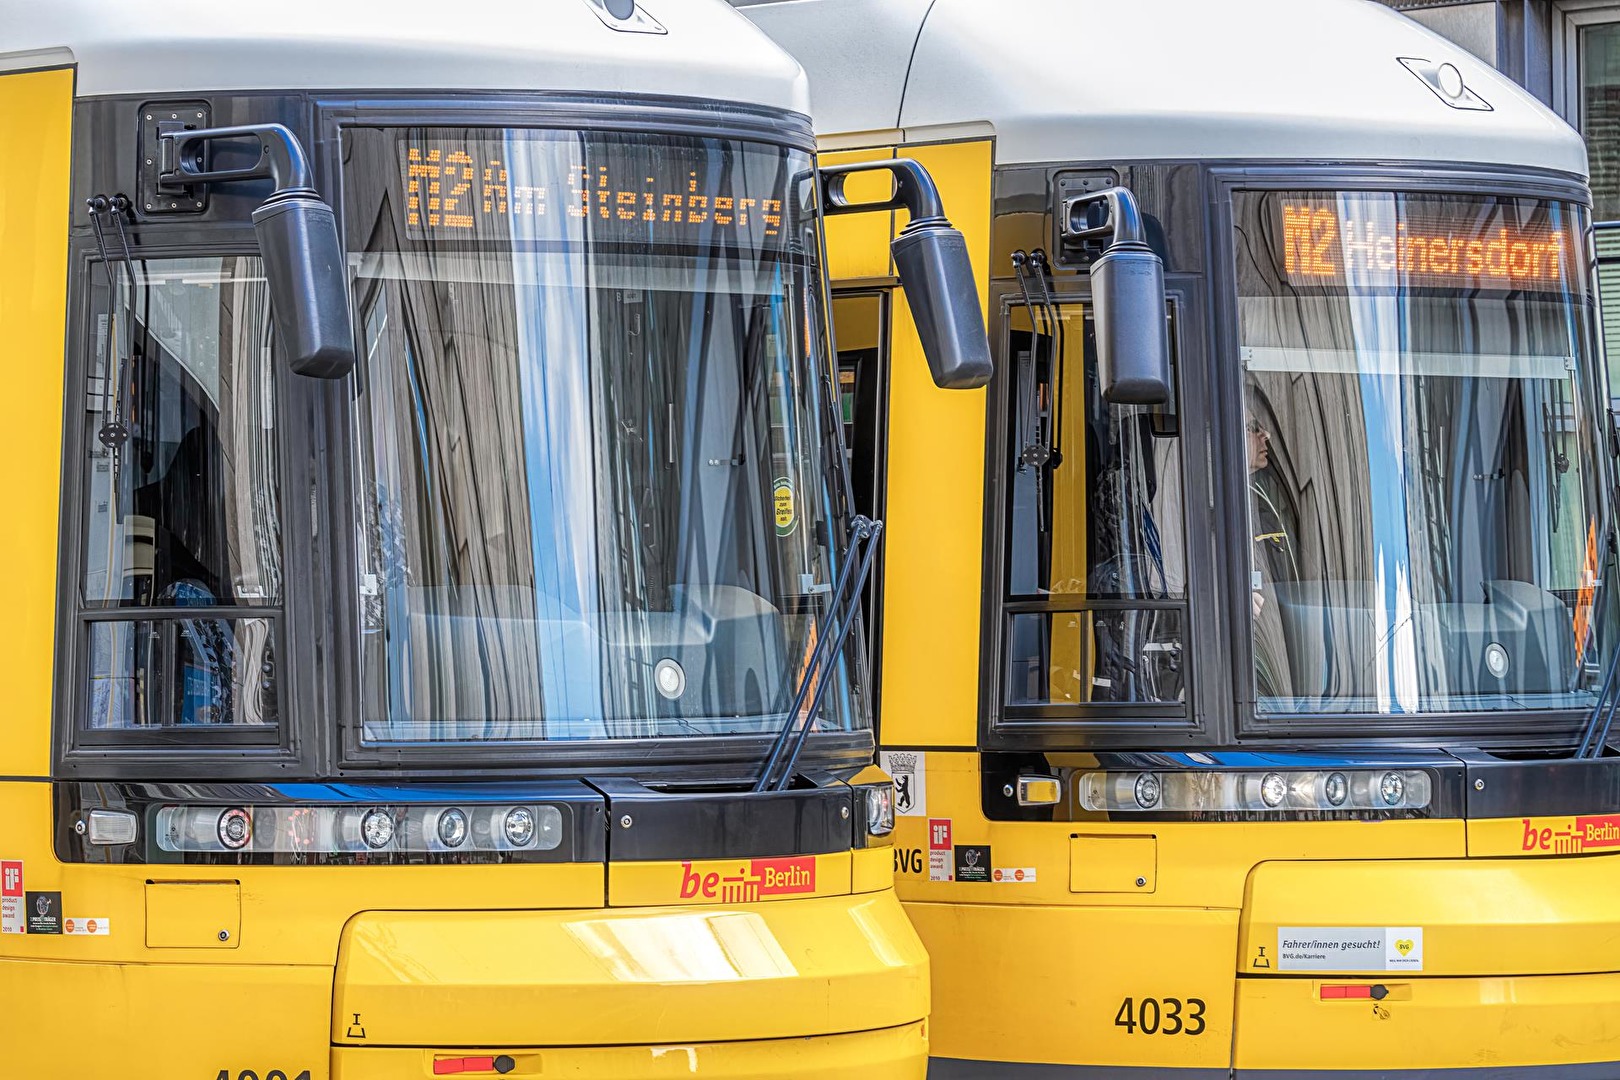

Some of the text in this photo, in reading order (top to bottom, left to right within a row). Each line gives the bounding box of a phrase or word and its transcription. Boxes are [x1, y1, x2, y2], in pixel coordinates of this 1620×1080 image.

[408, 148, 782, 235] M2 Am Steinberg
[1284, 205, 1562, 279] M2 Heinersdorf
[1522, 818, 1620, 851] be Berlin
[680, 861, 810, 899] be Berlin
[1282, 939, 1381, 951] Fahrer/innen gesucht!
[1114, 997, 1207, 1036] 4033
